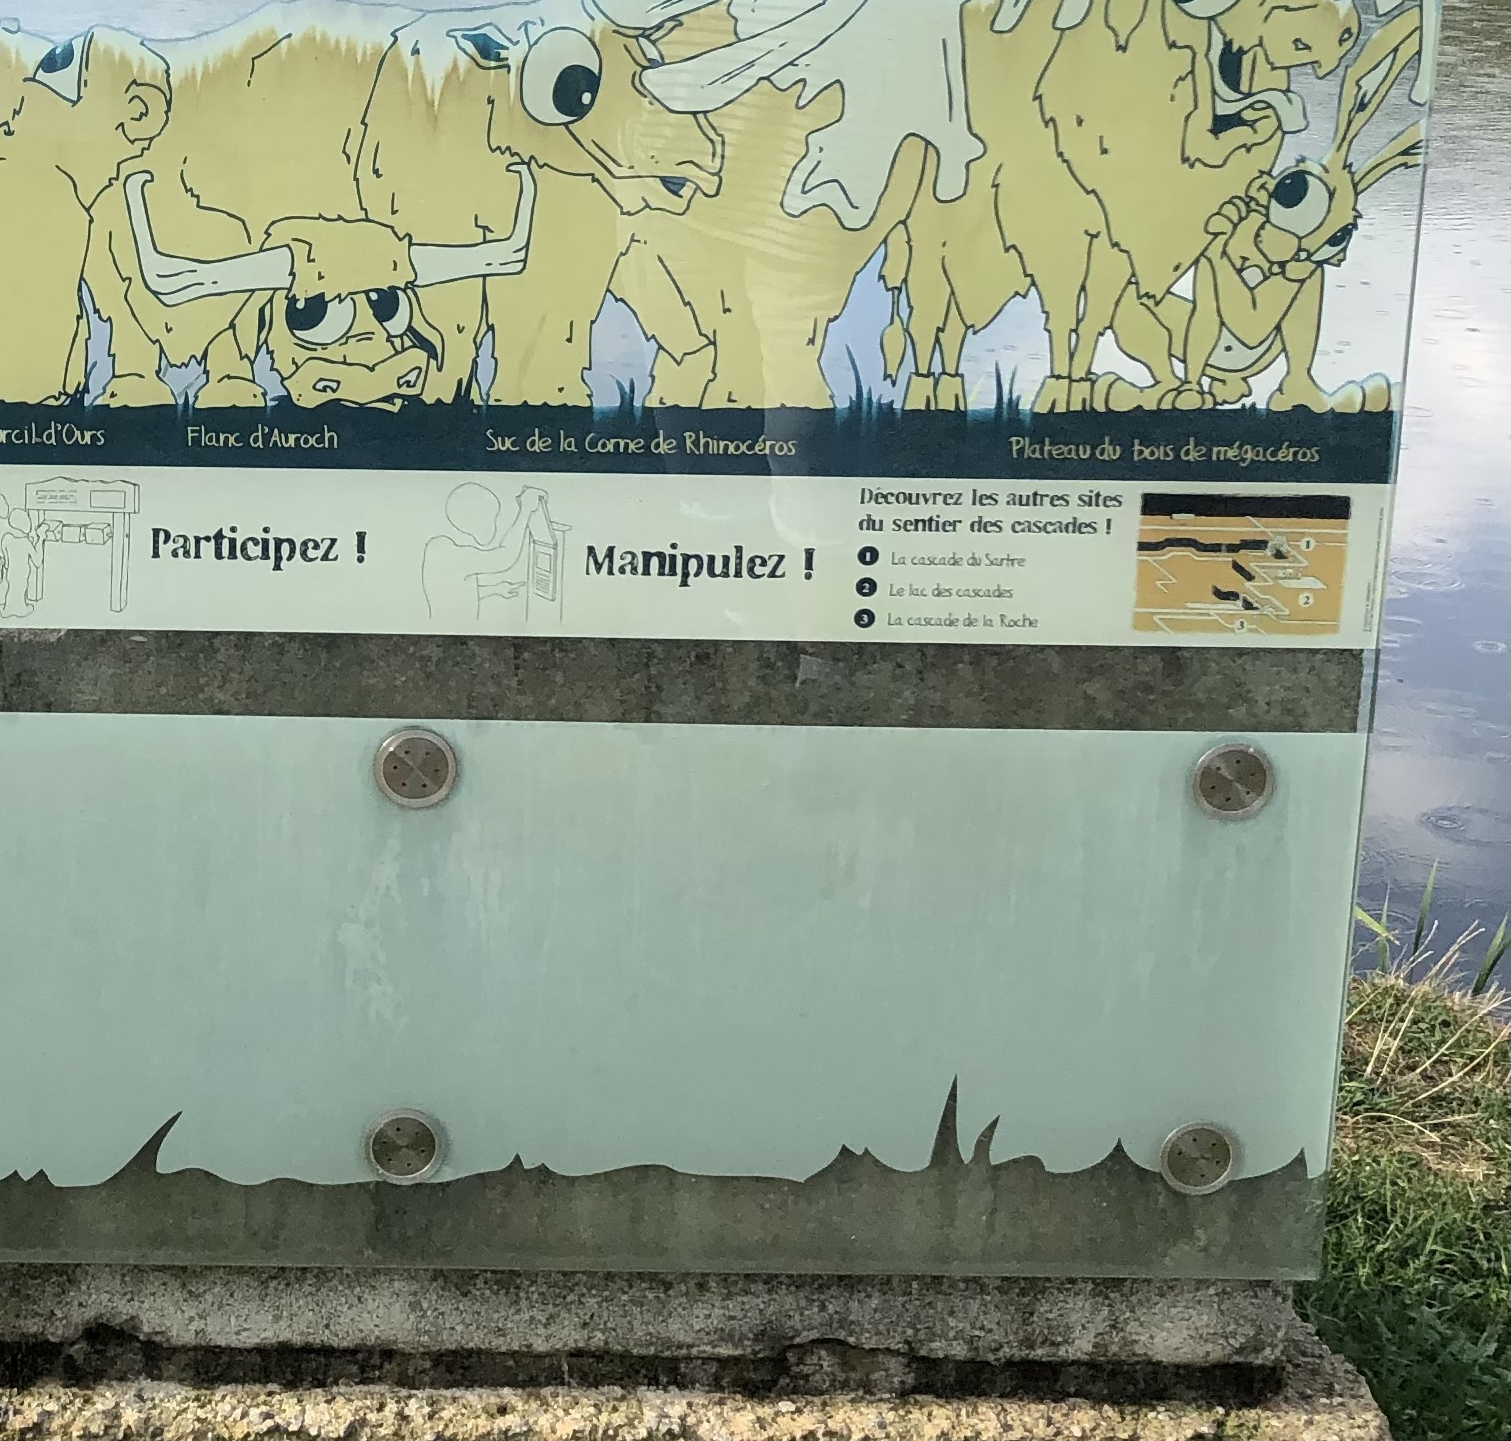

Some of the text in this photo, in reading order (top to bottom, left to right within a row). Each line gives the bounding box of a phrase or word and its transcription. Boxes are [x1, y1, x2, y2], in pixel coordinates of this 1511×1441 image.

[42, 422, 106, 447] d'Ours
[187, 425, 338, 449] Flanc d'Auroch
[485, 428, 797, 456] Suc de la Corne de Rhinocéros
[1009, 436, 1320, 467] Plateau du bois de mégacéros
[860, 487, 1123, 508] Découvrez les autres sites
[858, 514, 1112, 535] du sentier des cascades !
[151, 525, 368, 571] Participez !
[864, 551, 871, 561] 1
[891, 552, 906, 566] La
[910, 551, 963, 566] cascade
[967, 552, 981, 567] du
[585, 542, 816, 588] Manipulez !
[862, 583, 1014, 599] 2 Le lac des cascades
[860, 613, 1039, 629] 3 La cascade de la Roche
